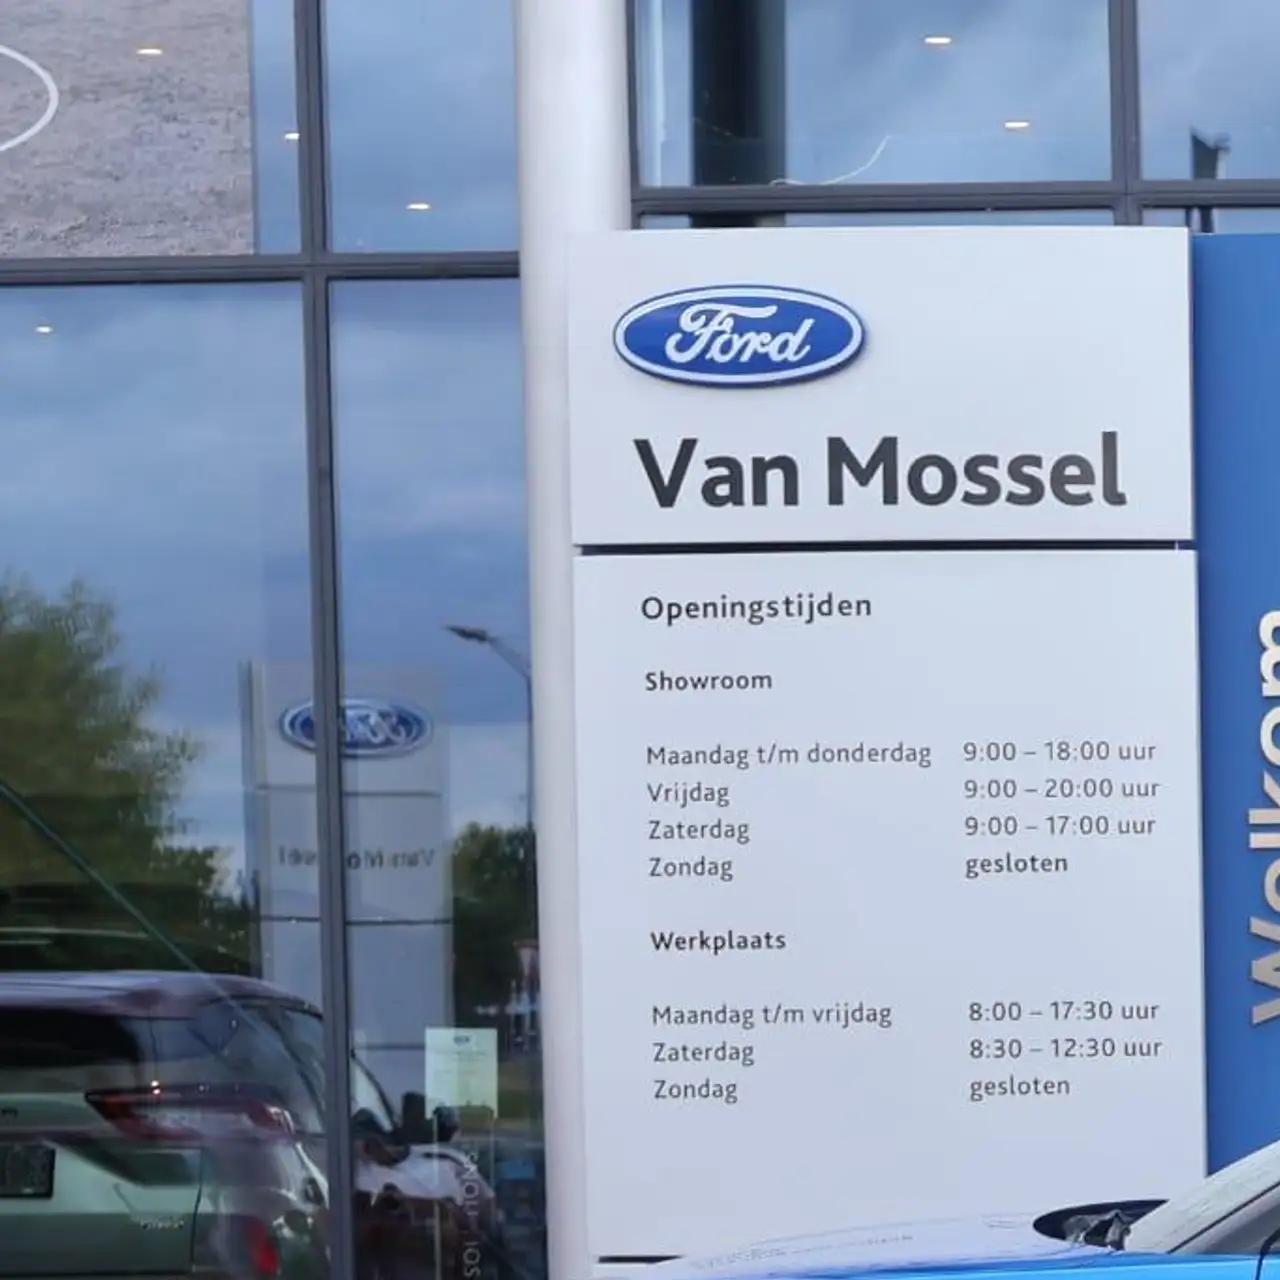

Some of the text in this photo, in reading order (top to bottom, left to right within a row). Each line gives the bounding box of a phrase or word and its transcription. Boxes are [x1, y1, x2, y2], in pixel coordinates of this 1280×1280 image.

[664, 303, 815, 364] Ford
[633, 431, 1127, 508] Van Mossel
[641, 591, 872, 627] Openingstijden
[645, 669, 773, 692] Showroom
[646, 744, 750, 770] Maandag
[757, 742, 799, 765] t/m
[806, 741, 932, 768] donderdag
[963, 741, 1017, 762] 9:00
[1043, 741, 1110, 762] 18:00
[1118, 745, 1157, 761] uur
[647, 781, 731, 808] Vrijdag
[963, 778, 1018, 799] 9:00
[1044, 777, 1114, 799] 20:00
[1121, 782, 1161, 798] uur
[648, 818, 751, 845] Zaterdag
[964, 816, 1018, 837] 9:00
[1045, 815, 1110, 836] 17:00
[1117, 819, 1157, 835] uur
[648, 852, 1069, 882] Zondag gesloten
[650, 929, 787, 957] Werkplaats
[652, 1004, 755, 1030] Maandag
[762, 1003, 804, 1024] t/m
[811, 1001, 893, 1029] vrijdag
[968, 1001, 1022, 1022] 8:00
[1049, 1000, 1114, 1021] 17:30
[1121, 1004, 1160, 1021] uur
[653, 1040, 755, 1067] Zaterdag
[969, 1038, 1023, 1060] 8:30
[1050, 1037, 1116, 1058] 12:30
[1123, 1041, 1163, 1057] uur
[653, 1074, 1070, 1104] Zondag gesloten
